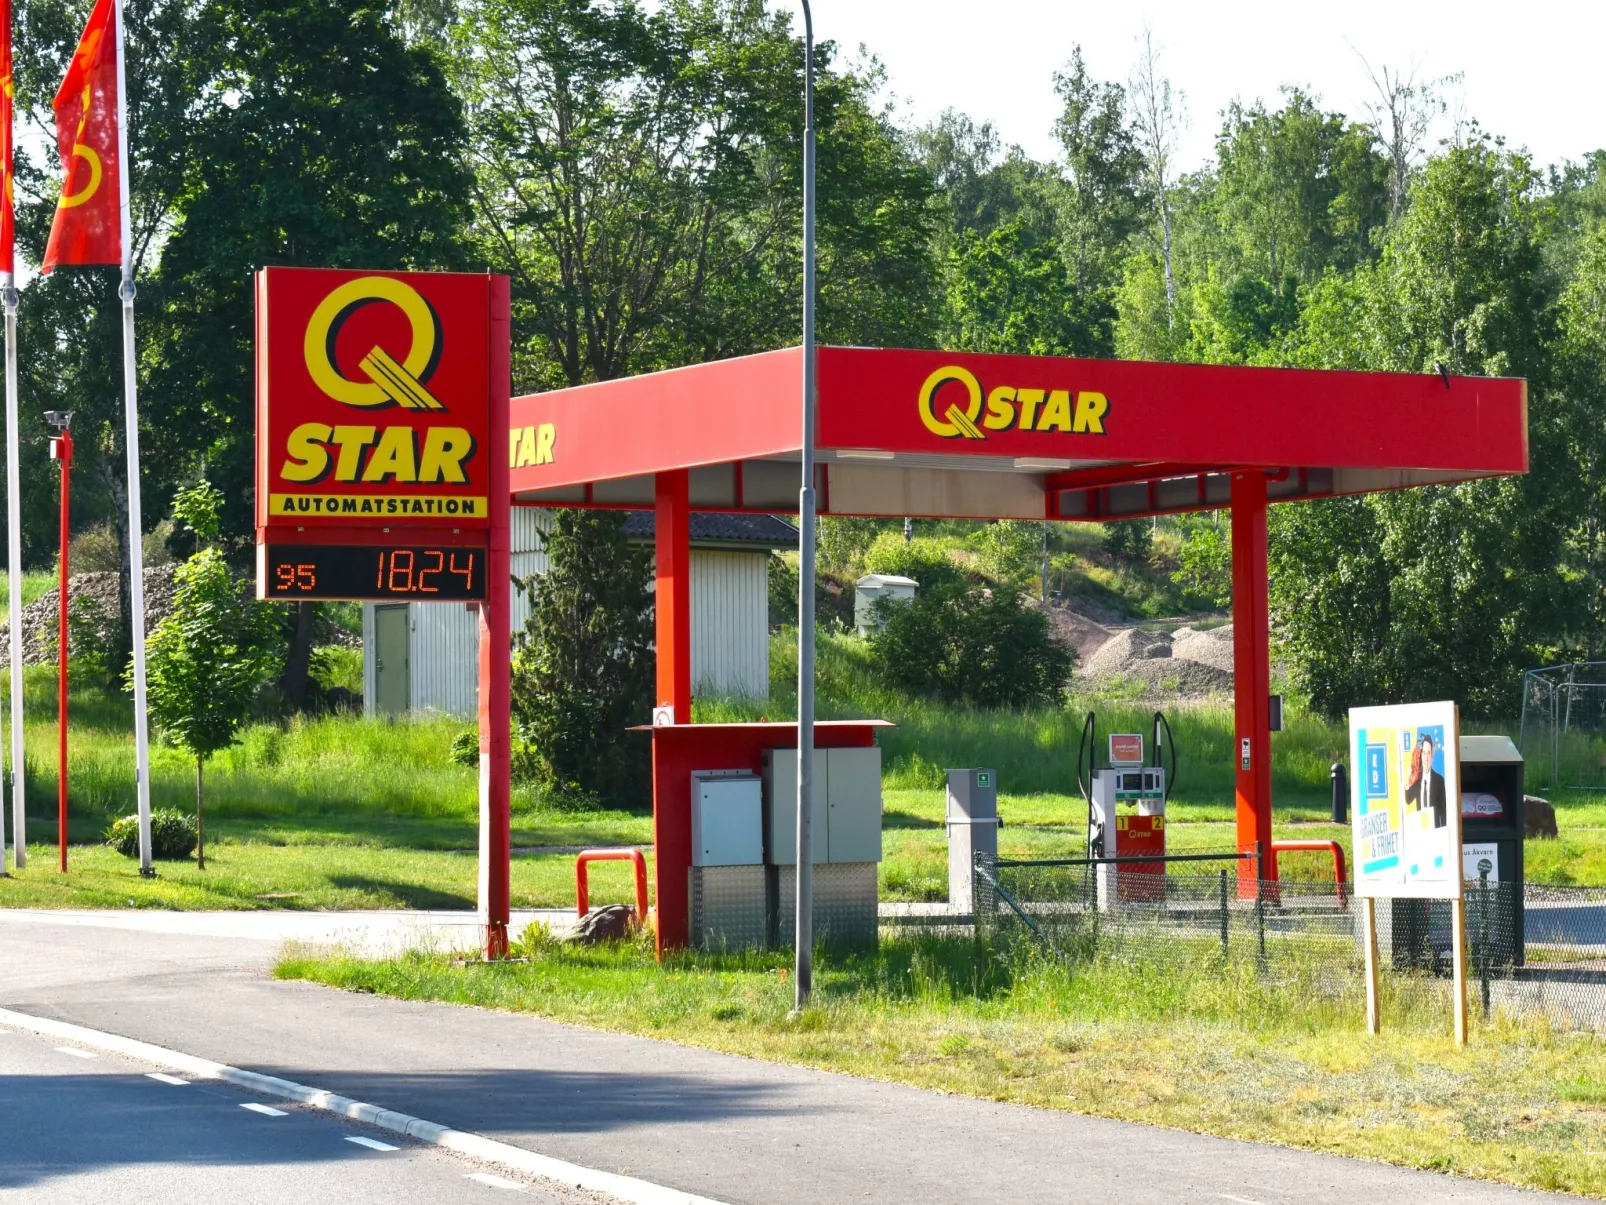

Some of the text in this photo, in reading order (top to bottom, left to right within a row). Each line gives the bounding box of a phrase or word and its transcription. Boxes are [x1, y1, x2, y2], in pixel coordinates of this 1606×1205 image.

[304, 276, 447, 413] Q
[280, 422, 477, 486] STAR
[283, 497, 475, 515] AUTOMATSTATION
[276, 550, 474, 592] 95 18.24
[1120, 818, 1125, 829] 1
[1154, 817, 1161, 829] 2
[1371, 831, 1399, 858] & FRIHET
